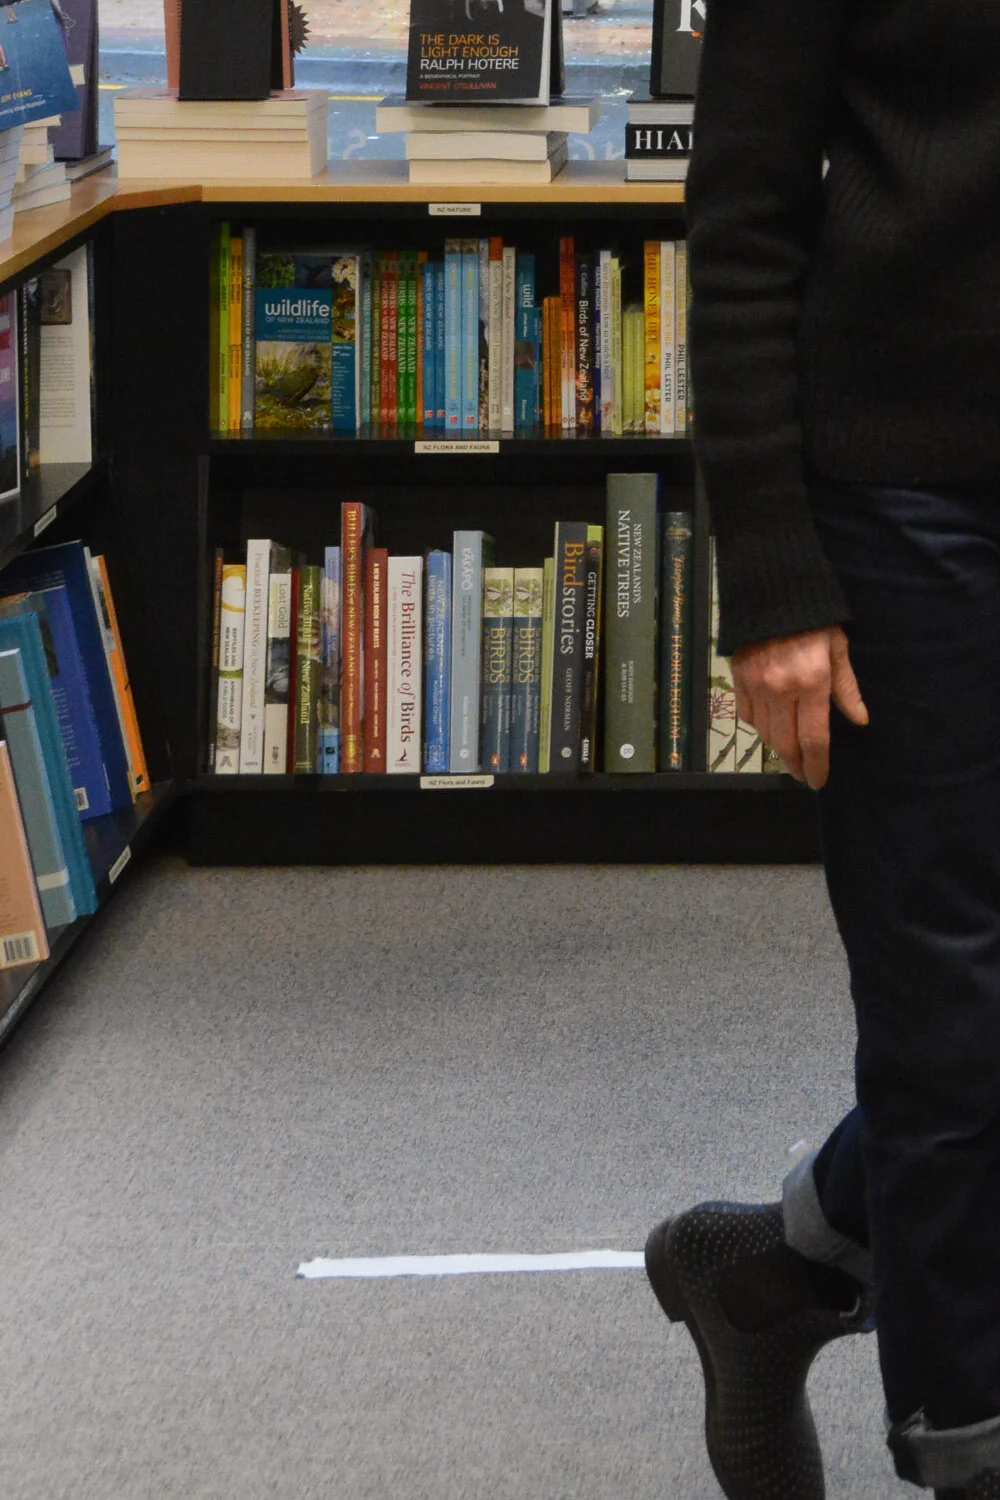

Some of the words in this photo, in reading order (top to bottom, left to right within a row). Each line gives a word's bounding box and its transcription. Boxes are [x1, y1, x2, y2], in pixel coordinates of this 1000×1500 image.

[420, 33, 445, 46] THE
[448, 33, 485, 46] DARK
[488, 33, 500, 46] IS
[421, 46, 460, 59] LIGHT
[462, 46, 519, 58] ENOUGH
[420, 58, 464, 71] RALPH
[467, 58, 520, 71] HOTERE
[265, 299, 330, 317] wildlife
[522, 284, 534, 308] wild
[579, 300, 589, 327] Birds
[579, 338, 589, 358] New
[664, 352, 672, 370] PHIL
[677, 344, 685, 365] PHIL
[579, 358, 589, 401] Zealand
[664, 371, 672, 403] LESTER
[677, 366, 685, 401] LESTER
[619, 510, 631, 567] NATIVE
[633, 523, 642, 548] NEW
[278, 583, 288, 605] Lost
[401, 572, 416, 598] The
[587, 571, 597, 617] GETTING
[617, 569, 630, 618] TREES
[560, 542, 584, 655] Birdstories
[278, 606, 288, 629] Gold
[401, 601, 416, 678] Brilliance
[585, 618, 595, 659] CLOSER
[490, 627, 506, 684] BIRDS
[518, 627, 536, 684] BIRDS
[400, 681, 415, 697] of
[564, 668, 572, 693] GEOFF
[400, 698, 415, 743] Birds
[564, 694, 572, 731] NORMAN
